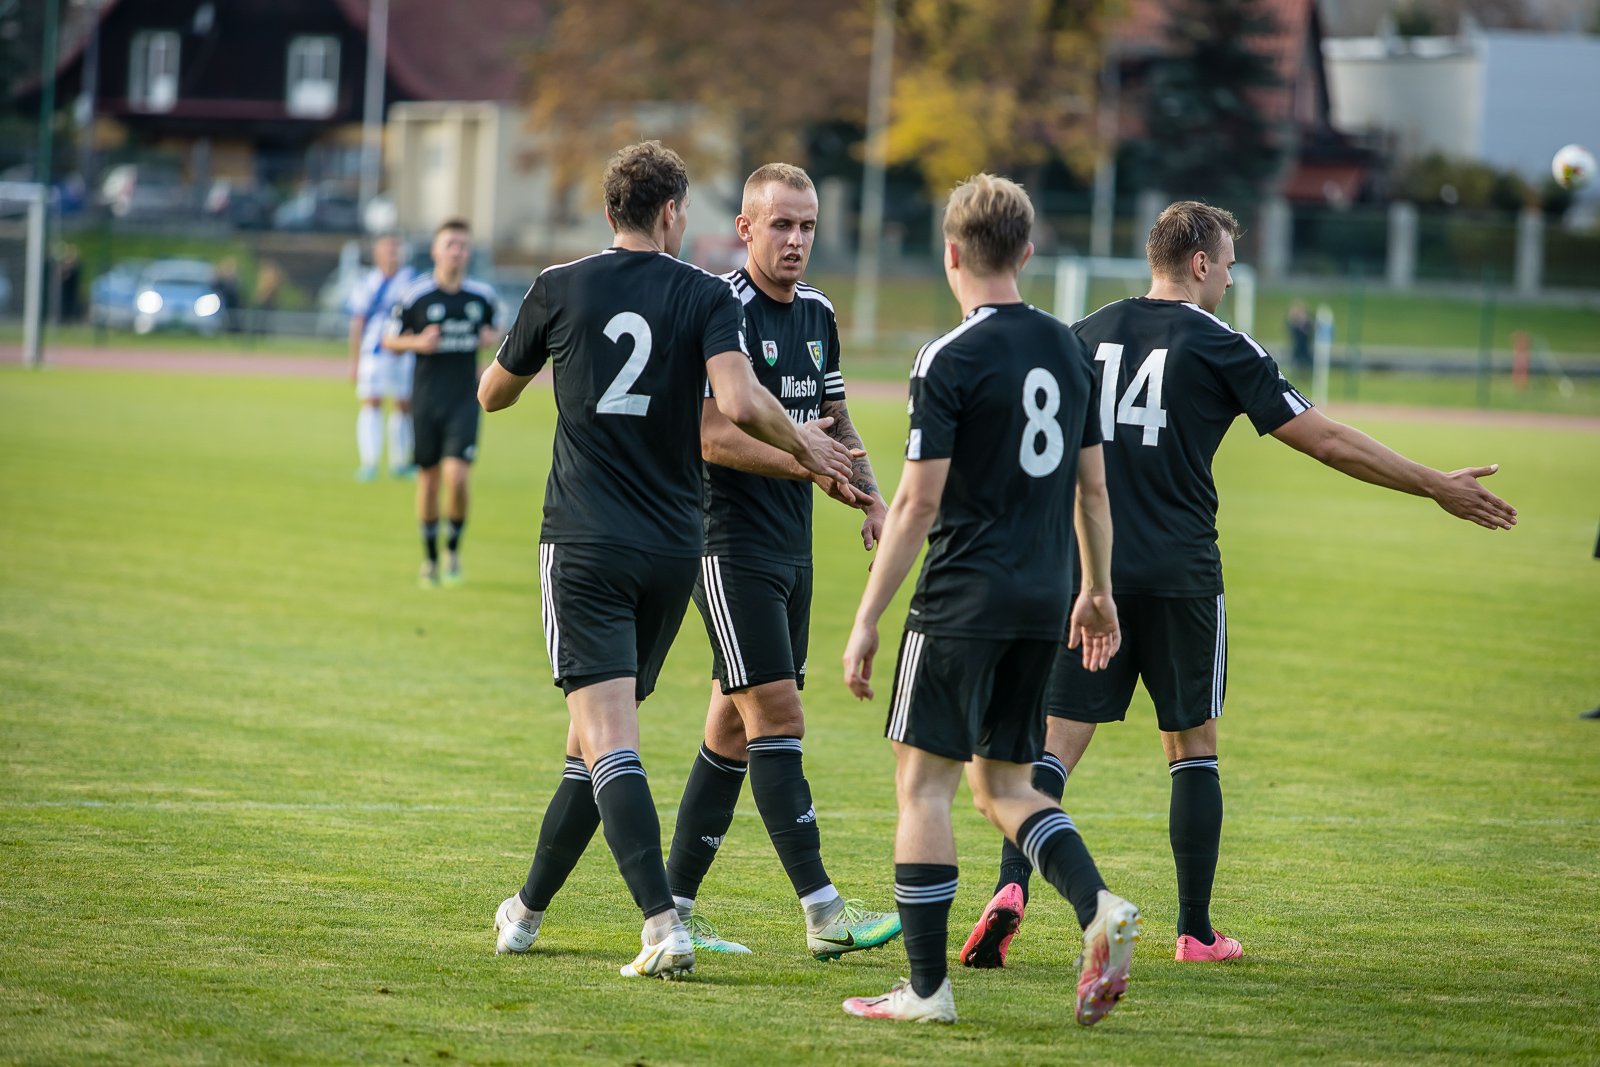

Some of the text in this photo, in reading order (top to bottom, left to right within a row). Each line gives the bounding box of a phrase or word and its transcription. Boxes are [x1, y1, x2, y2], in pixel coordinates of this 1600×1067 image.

[596, 312, 651, 416] 2
[780, 375, 817, 398] Miasto
[1093, 342, 1169, 447] 14
[1020, 367, 1064, 477] 8
